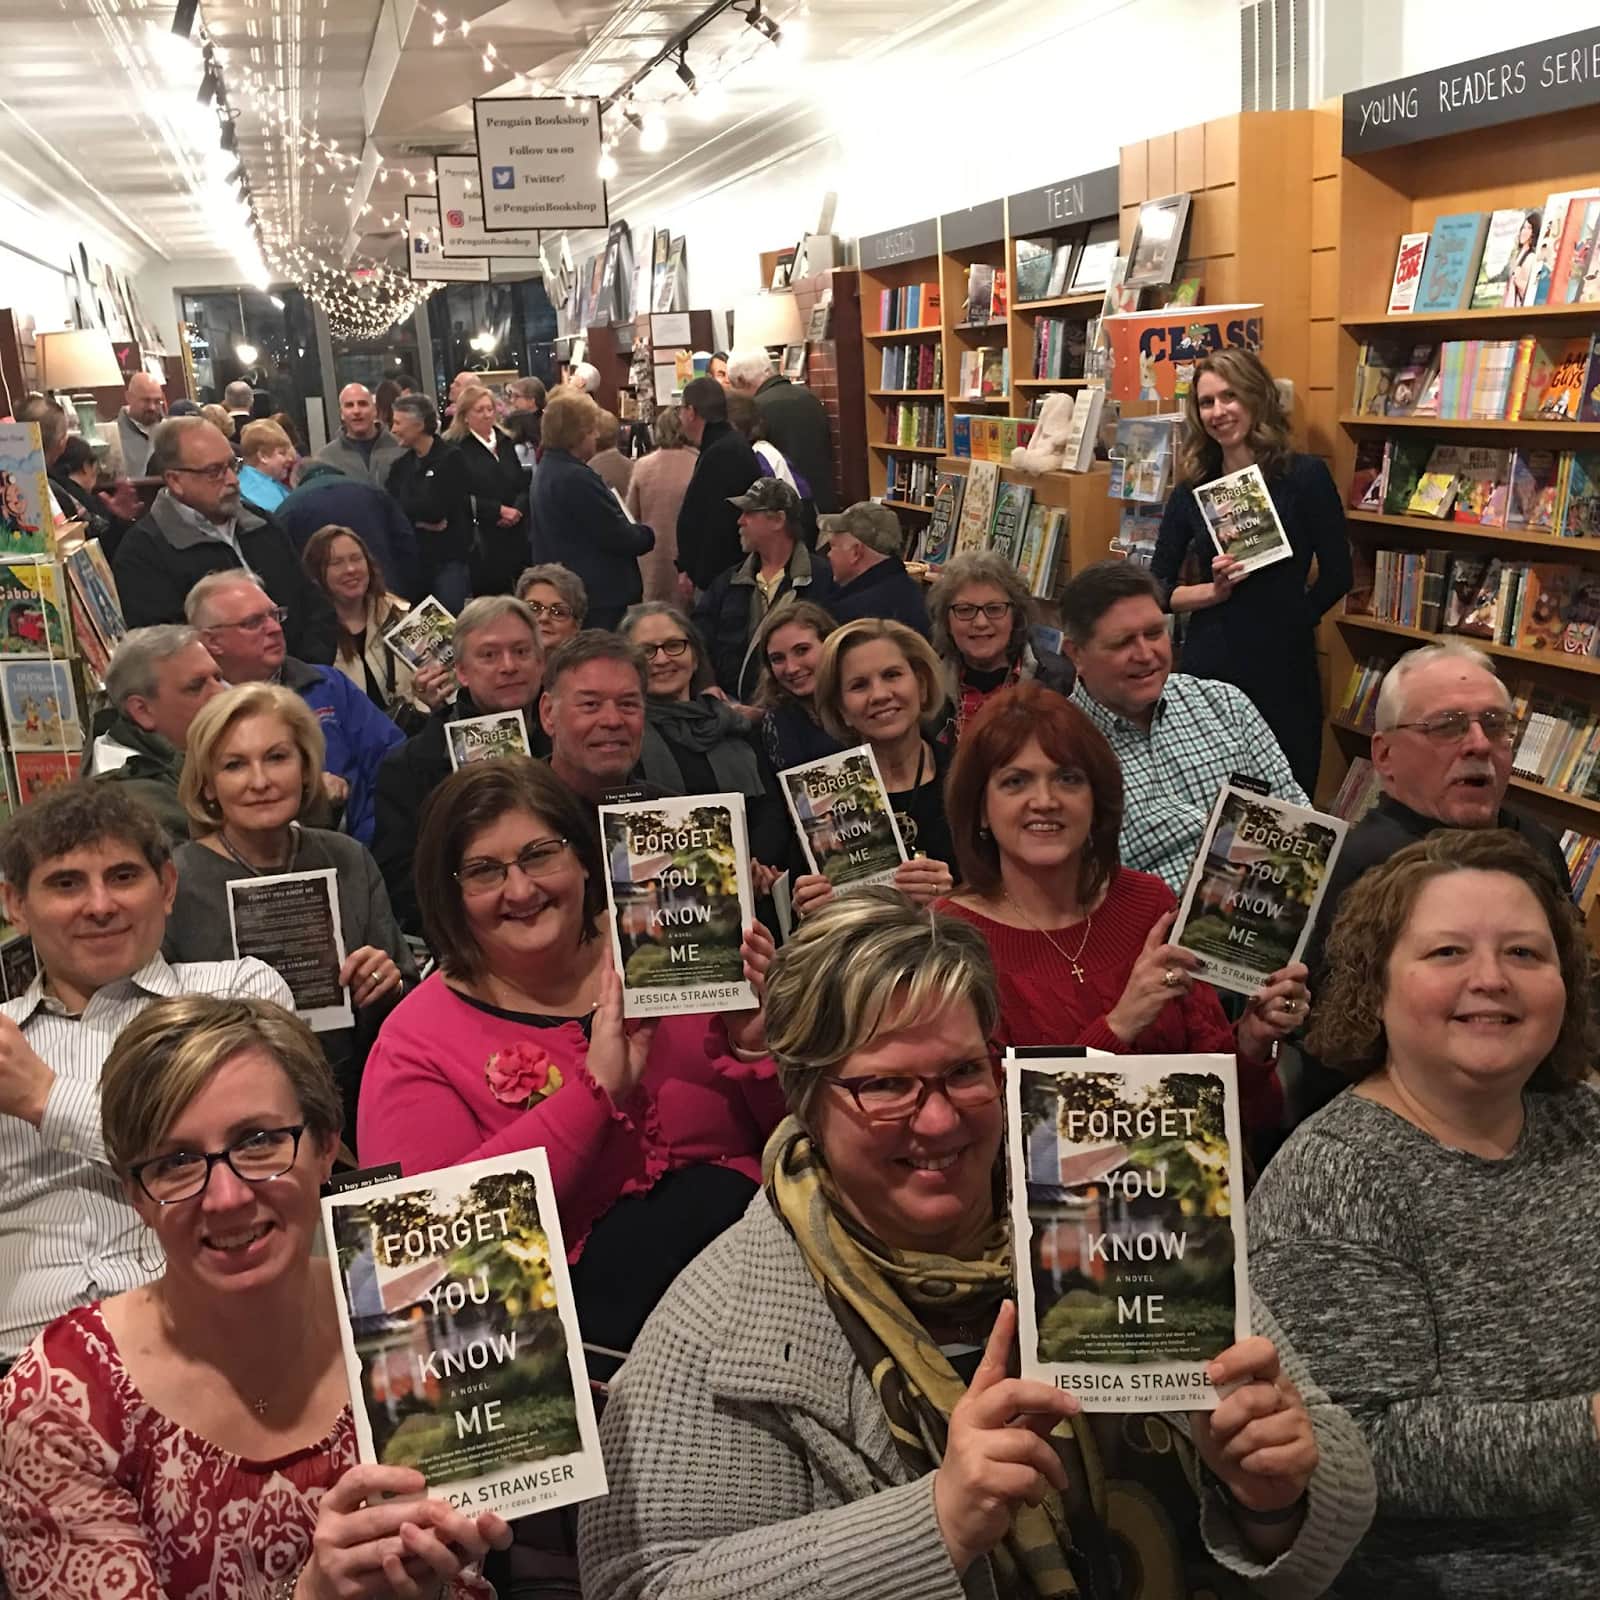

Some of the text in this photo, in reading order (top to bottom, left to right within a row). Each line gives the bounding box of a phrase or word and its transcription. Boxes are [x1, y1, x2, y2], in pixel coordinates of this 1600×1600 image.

[1359, 43, 1600, 137] YOUNG READERS SERIE
[486, 115, 590, 128] Penguin Bookshop
[509, 146, 575, 156] Follow us on
[523, 174, 566, 185] Twitter!
[493, 200, 598, 214] @PenguinBookshop
[1044, 181, 1084, 223] TEEN
[1139, 316, 1265, 363] CLASS
[1551, 370, 1585, 388] GUYS
[1213, 482, 1253, 506] FORGET
[1232, 500, 1250, 517] YOU
[1233, 515, 1261, 534] KNOW
[1244, 534, 1261, 548] ME
[406, 614, 440, 644] FORGET
[466, 727, 512, 747] FORGET
[808, 769, 864, 798] FORGET
[831, 796, 858, 817] YOU
[632, 828, 715, 853] FORGET
[830, 820, 873, 843] KNOW
[1241, 823, 1318, 859] FORGET
[848, 847, 872, 865] ME
[657, 866, 698, 889] YOU
[1250, 861, 1290, 885] YOU
[650, 905, 713, 928] KNOW
[1226, 890, 1286, 920] KNOW
[1227, 925, 1259, 948] ME
[669, 943, 701, 964] ME
[1220, 966, 1268, 986] STRAWSE
[633, 986, 740, 1005] JESSICA STRAWSER
[1066, 1107, 1198, 1138] FORGET
[345, 1183, 359, 1191] buy
[374, 1173, 398, 1184] books
[1102, 1166, 1169, 1200] YOU
[382, 1207, 511, 1264] FORGET
[1087, 1230, 1188, 1263] KNOW
[1115, 1274, 1155, 1283] A NOVEL
[424, 1273, 491, 1316] YOU
[1116, 1294, 1166, 1325] ME
[417, 1331, 518, 1384] KNOW
[451, 1382, 490, 1398] A NOVEL
[1131, 1371, 1212, 1390] STRAWSE
[1135, 1394, 1153, 1402] THAT
[454, 1399, 506, 1440] ME
[477, 1464, 576, 1503] STRAWSER
[511, 1495, 537, 1508] COULD
[540, 1491, 558, 1502] TELL
